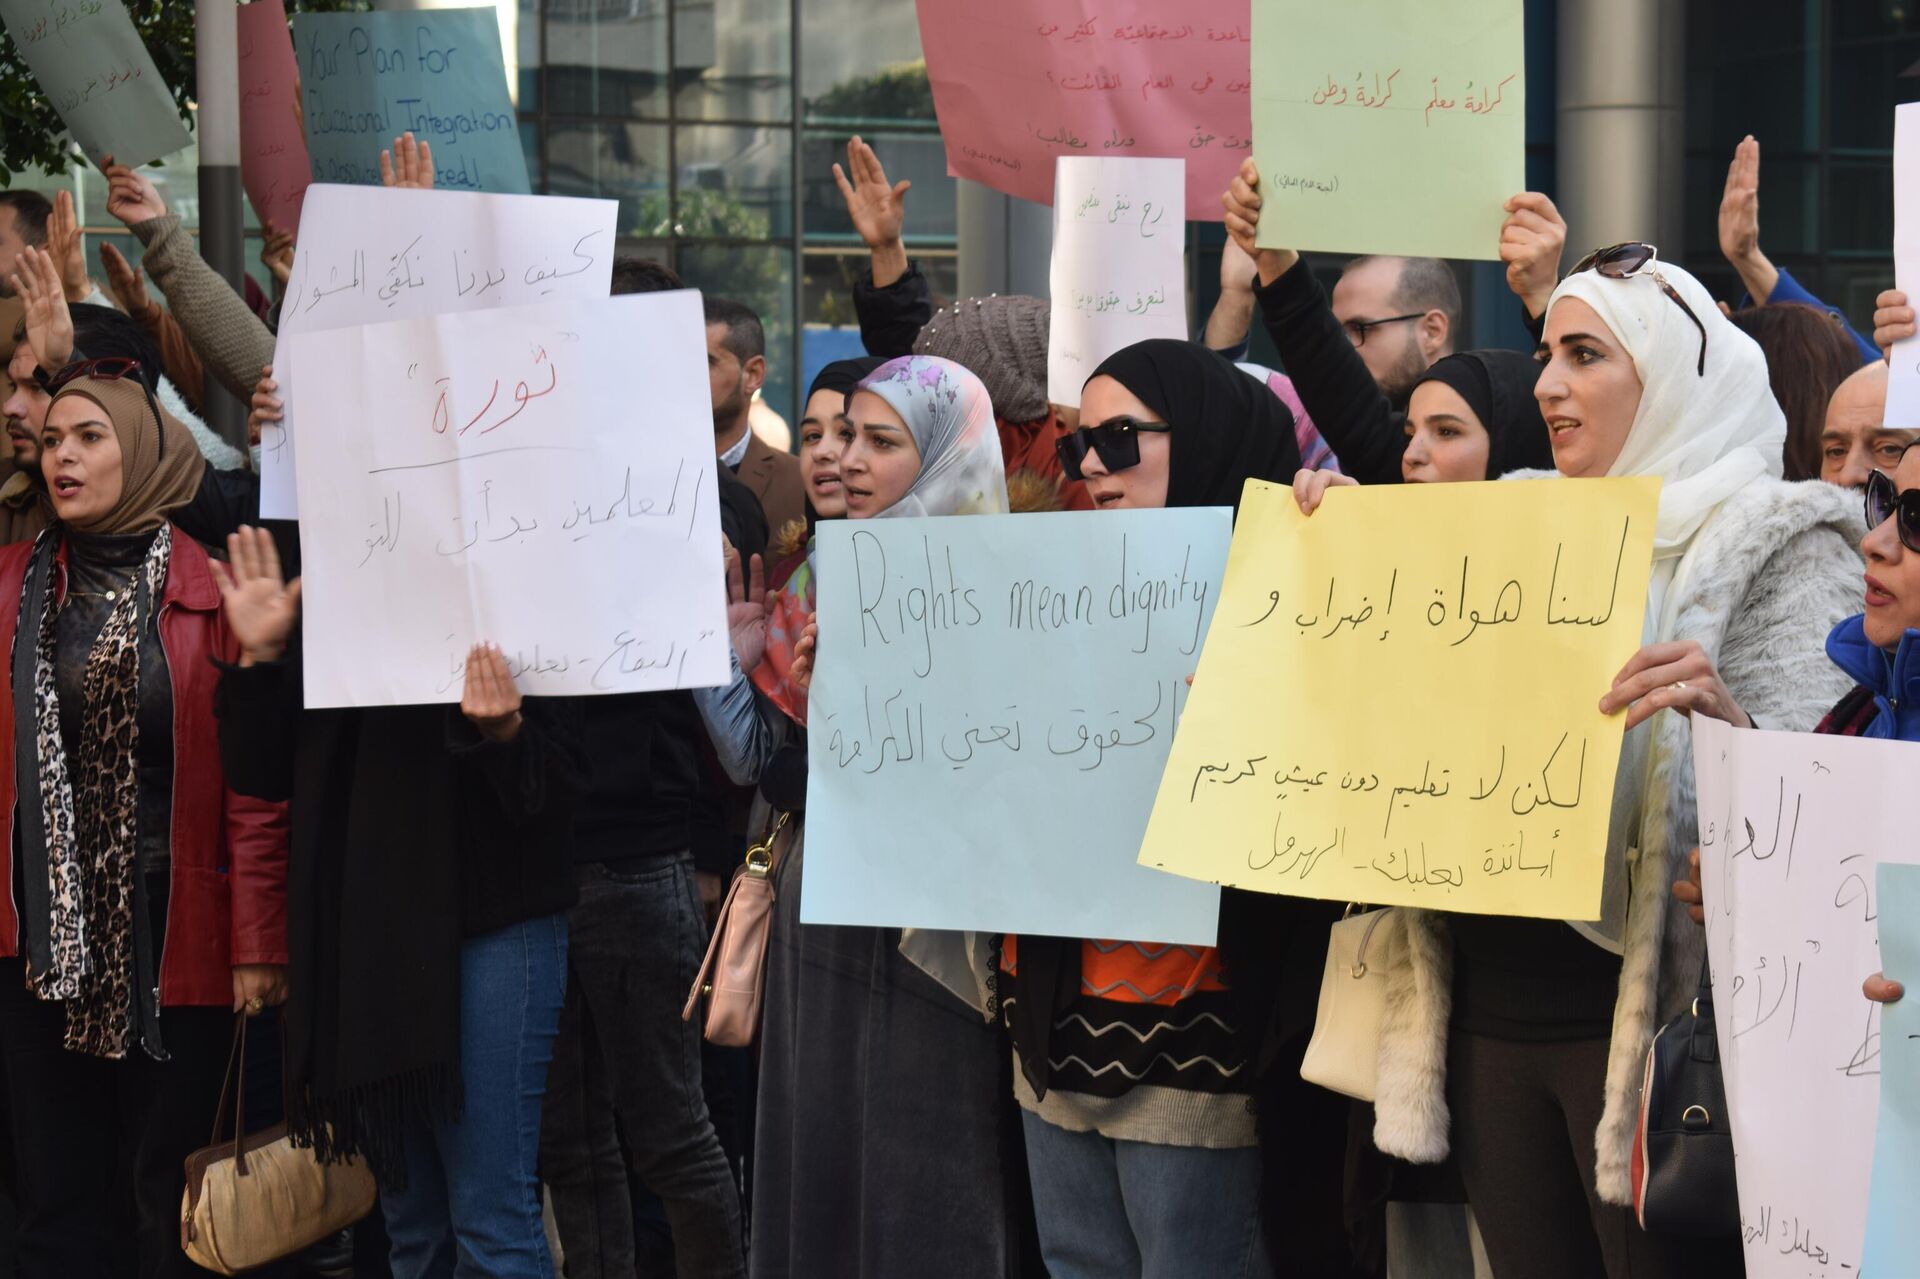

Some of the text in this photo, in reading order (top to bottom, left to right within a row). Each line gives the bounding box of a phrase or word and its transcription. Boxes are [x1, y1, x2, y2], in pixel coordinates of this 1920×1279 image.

[308, 28, 341, 80] Your
[349, 26, 405, 76] Plan
[1141, 74, 1175, 102] العام
[396, 98, 512, 145] Integration
[523, 229, 604, 297] كيف
[561, 457, 704, 543] المعلمين
[851, 530, 1208, 679] Rights mean dignity
[1239, 514, 1630, 647] لسنا هواة إضراب و
[827, 679, 1177, 775] الحقوق تعني الكرامة
[1190, 755, 1268, 804] كريم
[1340, 771, 1380, 793] دون
[1383, 759, 1451, 840] تعليم
[1468, 744, 1506, 801] لا
[1511, 731, 1587, 816] لكن
[1482, 828, 1561, 880] أساتذة
